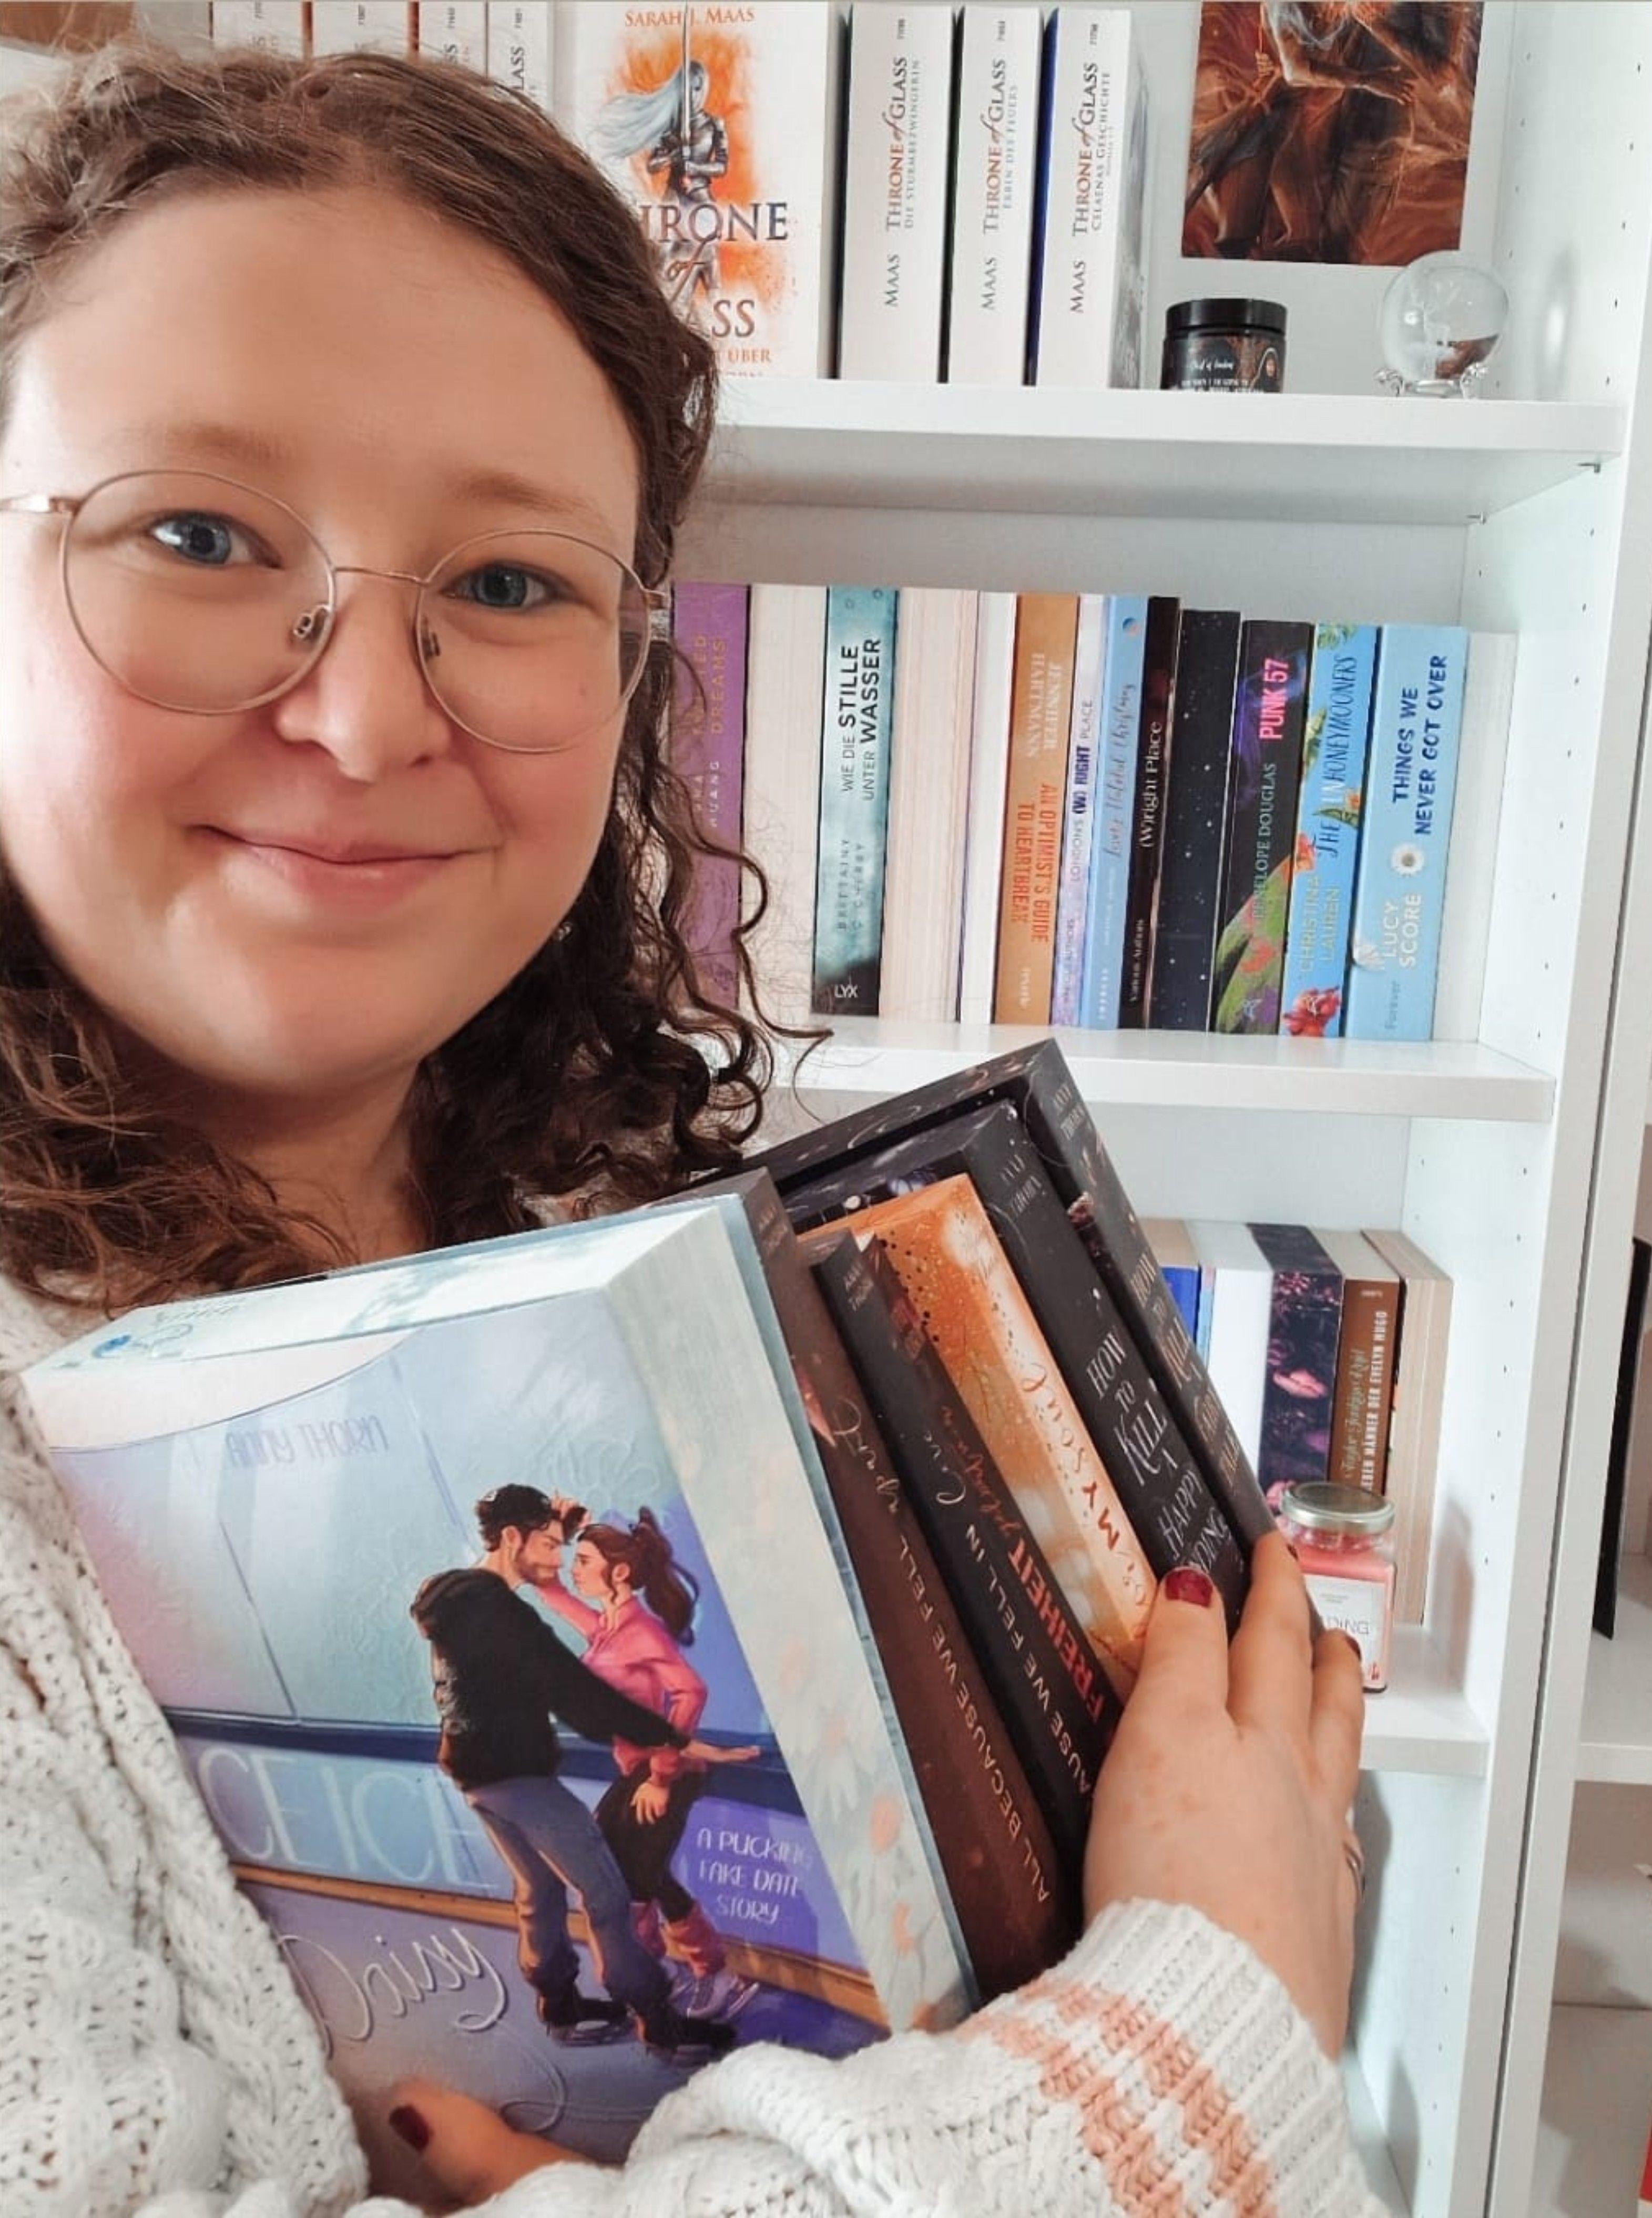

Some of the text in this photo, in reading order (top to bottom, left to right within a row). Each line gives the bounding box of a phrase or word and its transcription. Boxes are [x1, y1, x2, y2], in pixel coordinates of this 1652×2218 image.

[625, 7, 755, 27] SARAH J. MAAS
[509, 46, 526, 89] LASS
[889, 57, 907, 120] GLASS
[988, 58, 1006, 122] GLASS
[1079, 63, 1098, 126] GLASS
[882, 111, 904, 142] of
[980, 114, 1004, 144] of
[1072, 117, 1094, 147] of
[886, 144, 904, 231] THRONE
[983, 146, 1002, 235] THRONE
[1072, 149, 1093, 237] THRONE
[884, 254, 901, 307] MAAS
[981, 257, 997, 311] MAAS
[1072, 261, 1087, 314] MAAS
[711, 638, 727, 734] DREAMS
[838, 645, 858, 792] WIE DIE STILLE
[1027, 652, 1045, 758] HARTMANN
[1043, 662, 1063, 751] JENNIFER
[1259, 657, 1290, 740] PUNK 57
[860, 639, 881, 801] UNTER WASSER
[1080, 700, 1093, 739] PLACE
[1392, 687, 1419, 804] THINGS WE
[1414, 655, 1447, 835] NEVER GOT OVER
[709, 761, 720, 829] HUANG
[1074, 745, 1090, 785] RIGHT
[1139, 721, 1162, 850] (W)right Place
[1072, 791, 1087, 814] (W)
[1011, 803, 1035, 923] TO HEARTBREAK
[1031, 783, 1057, 943] AN OPTIMIST'S GUIDE
[1251, 762, 1277, 919] PENELOPE DOUGLAS
[1314, 821, 1342, 858] THE
[1299, 875, 1321, 973] CHRISTINA
[1319, 886, 1341, 962] LAUREN
[1382, 901, 1399, 957] LUCY
[1399, 893, 1421, 970] SCORE
[834, 983, 859, 999] LYX
[1373, 1311, 1388, 1342] HUGO
[1086, 1326, 1128, 1398] HOW
[1370, 1345, 1386, 1384] EVELYN
[1115, 1379, 1136, 1414] TO
[1367, 1387, 1382, 1408] DER
[298, 1414, 390, 1459] THORN
[1113, 1399, 1168, 1487] KILL
[1362, 1412, 1379, 1457] MÄNNER
[966, 1524, 986, 1562] IN
[1158, 1469, 1204, 1561] HAPPY
[900, 1535, 934, 1623] FELL
[988, 1565, 1024, 1653] FELL
[931, 1624, 957, 1683] WE
[1007, 1537, 1105, 1724] FREIHEIT
[1022, 1653, 1052, 1712] WE
[954, 1682, 1022, 1839] BECAUSE
[1049, 1711, 1092, 1794] AUSE
[697, 1827, 711, 1849] A
[1023, 1837, 1049, 1903] ALL
[699, 1859, 746, 1887] FAKE
[715, 1895, 780, 1925] STORY
[273, 1926, 509, 2058] Daisy
